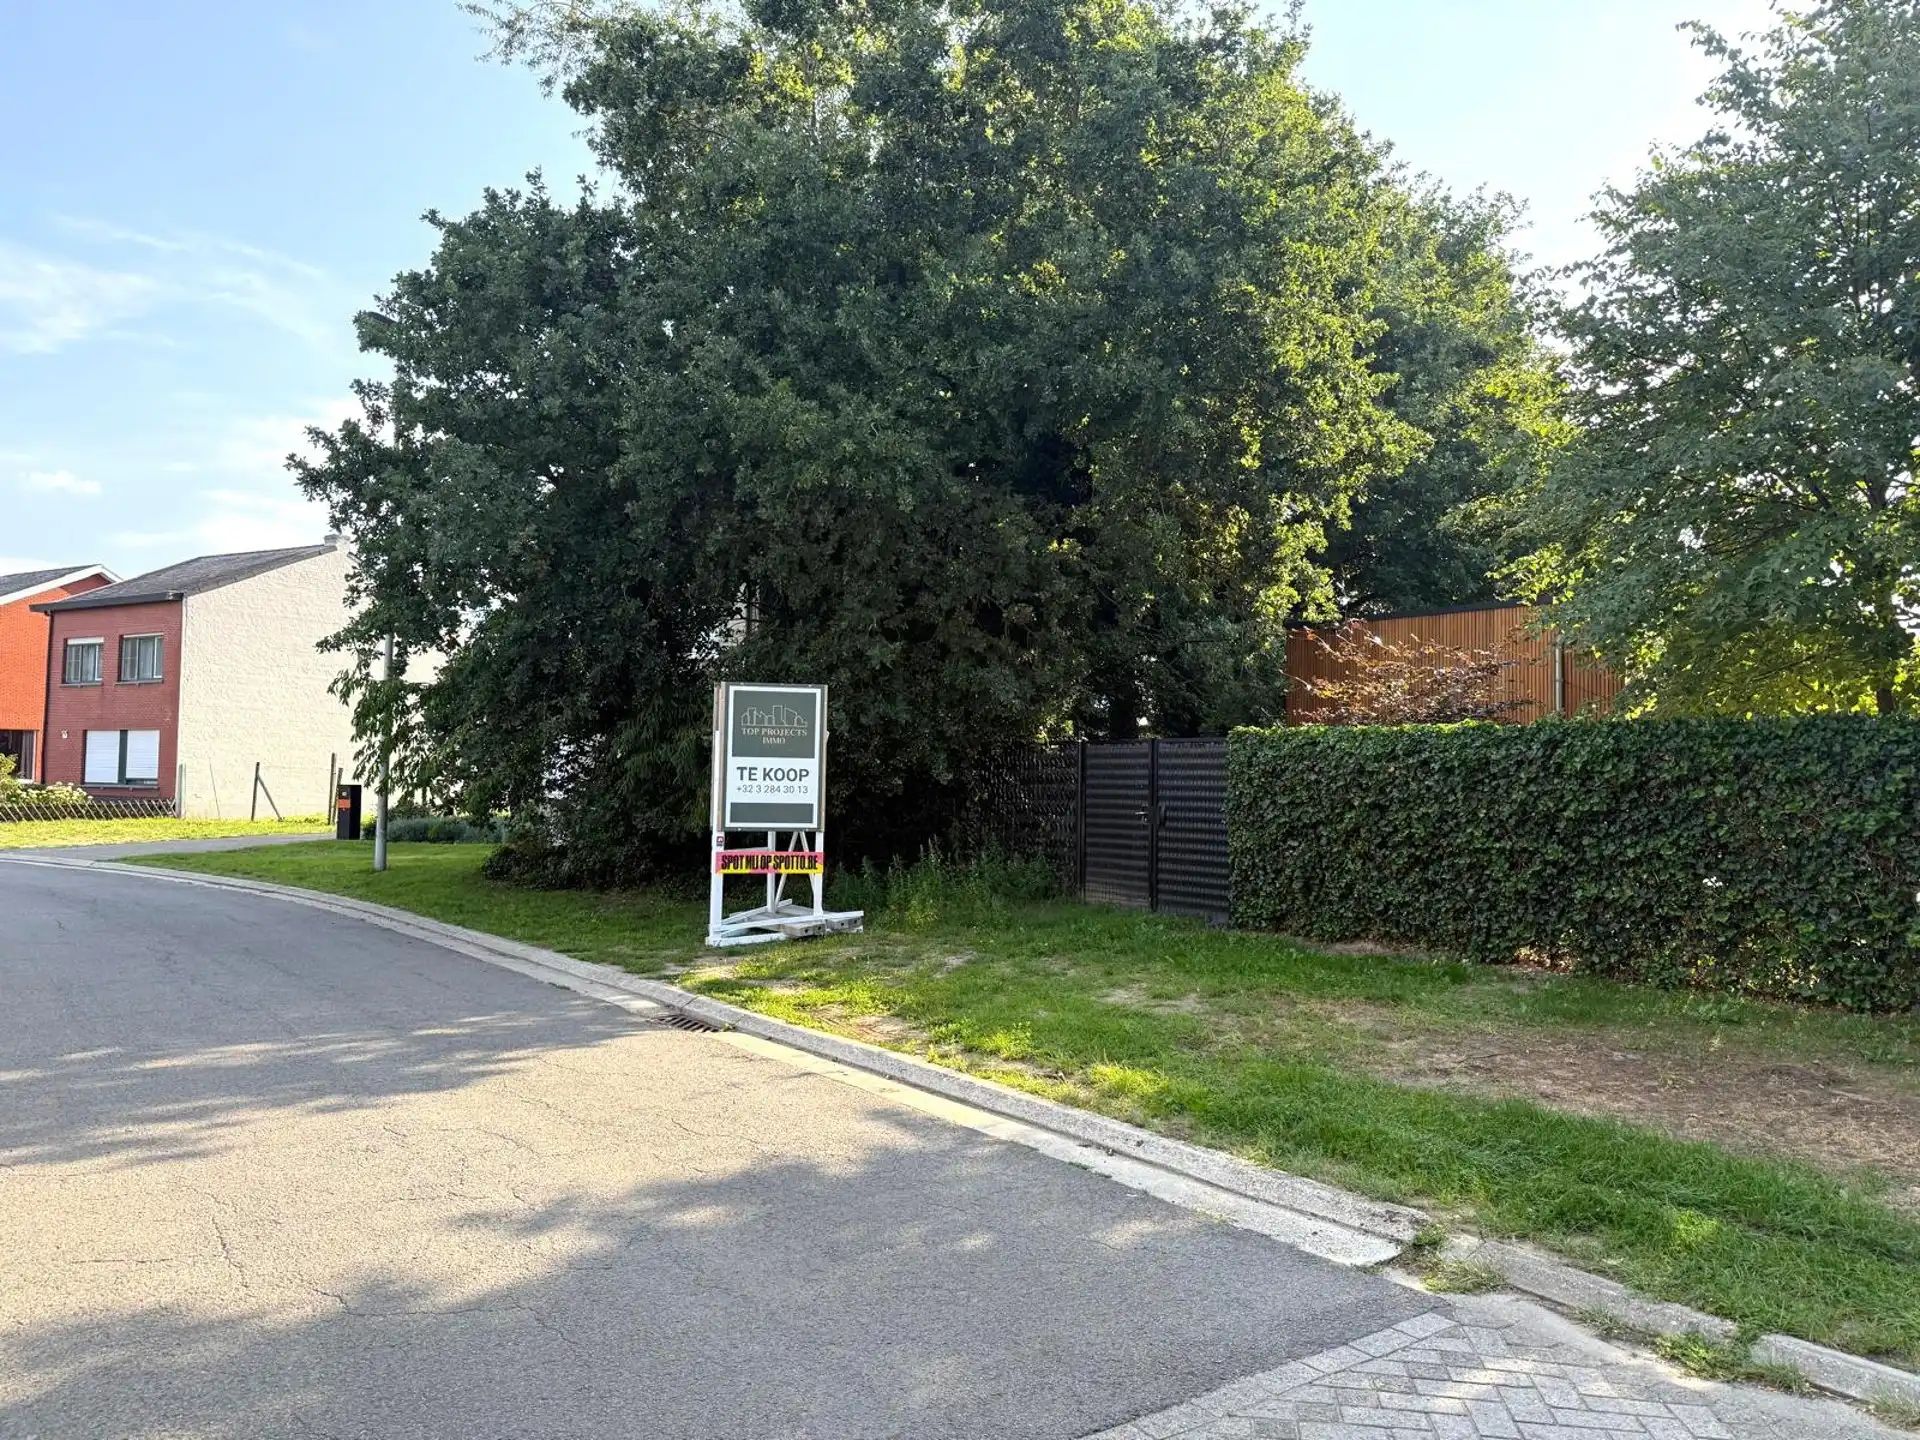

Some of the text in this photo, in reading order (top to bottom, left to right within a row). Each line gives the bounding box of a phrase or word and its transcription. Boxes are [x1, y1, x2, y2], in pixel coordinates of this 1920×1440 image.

[741, 728, 808, 737] TOP PROJECTS
[737, 767, 809, 782] TE KOOP
[737, 785, 809, 794] +32 3 284 30 13
[721, 855, 745, 870] SPOT
[760, 855, 772, 870] OP
[772, 855, 818, 870] SPOTTO.BE
